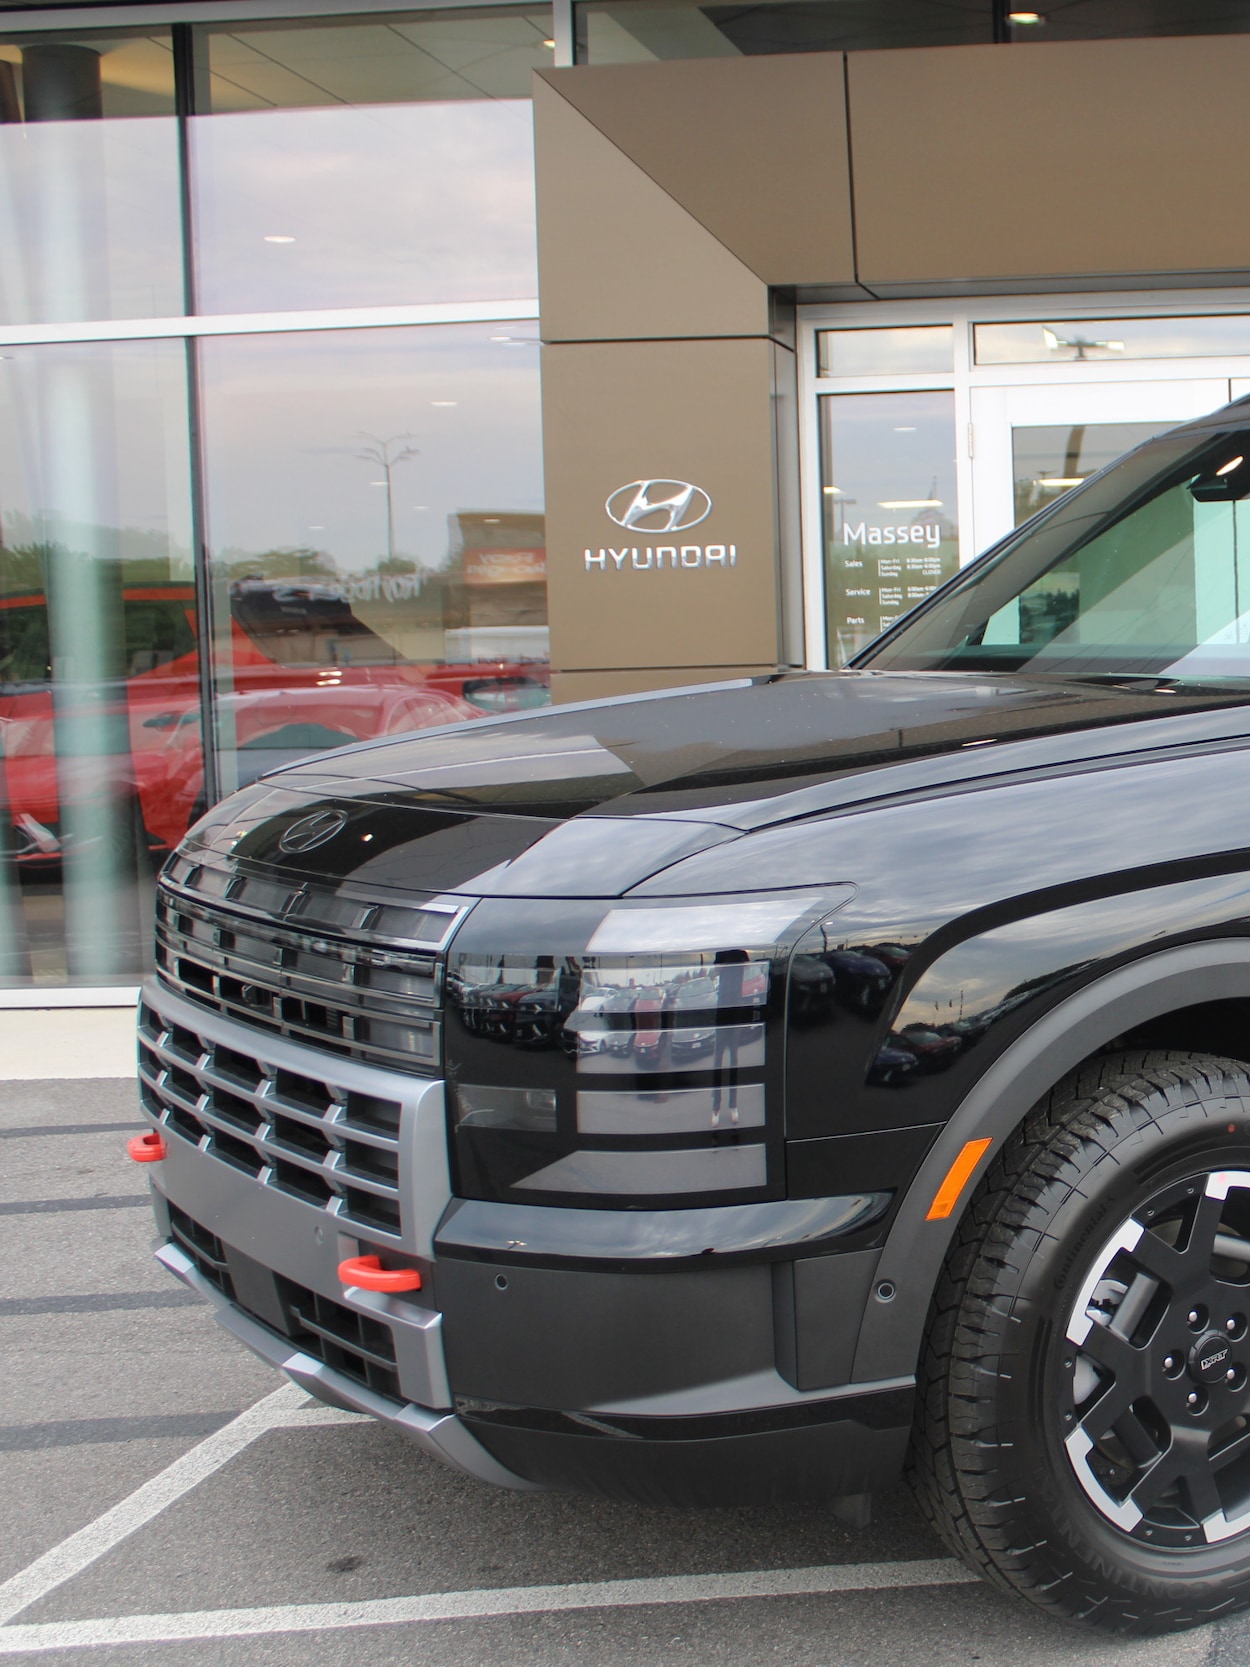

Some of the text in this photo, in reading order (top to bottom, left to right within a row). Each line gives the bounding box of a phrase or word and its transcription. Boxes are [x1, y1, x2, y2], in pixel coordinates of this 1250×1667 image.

[844, 522, 940, 548] Massey
[584, 544, 737, 572] HYUNDAI
[846, 588, 870, 596] Service
